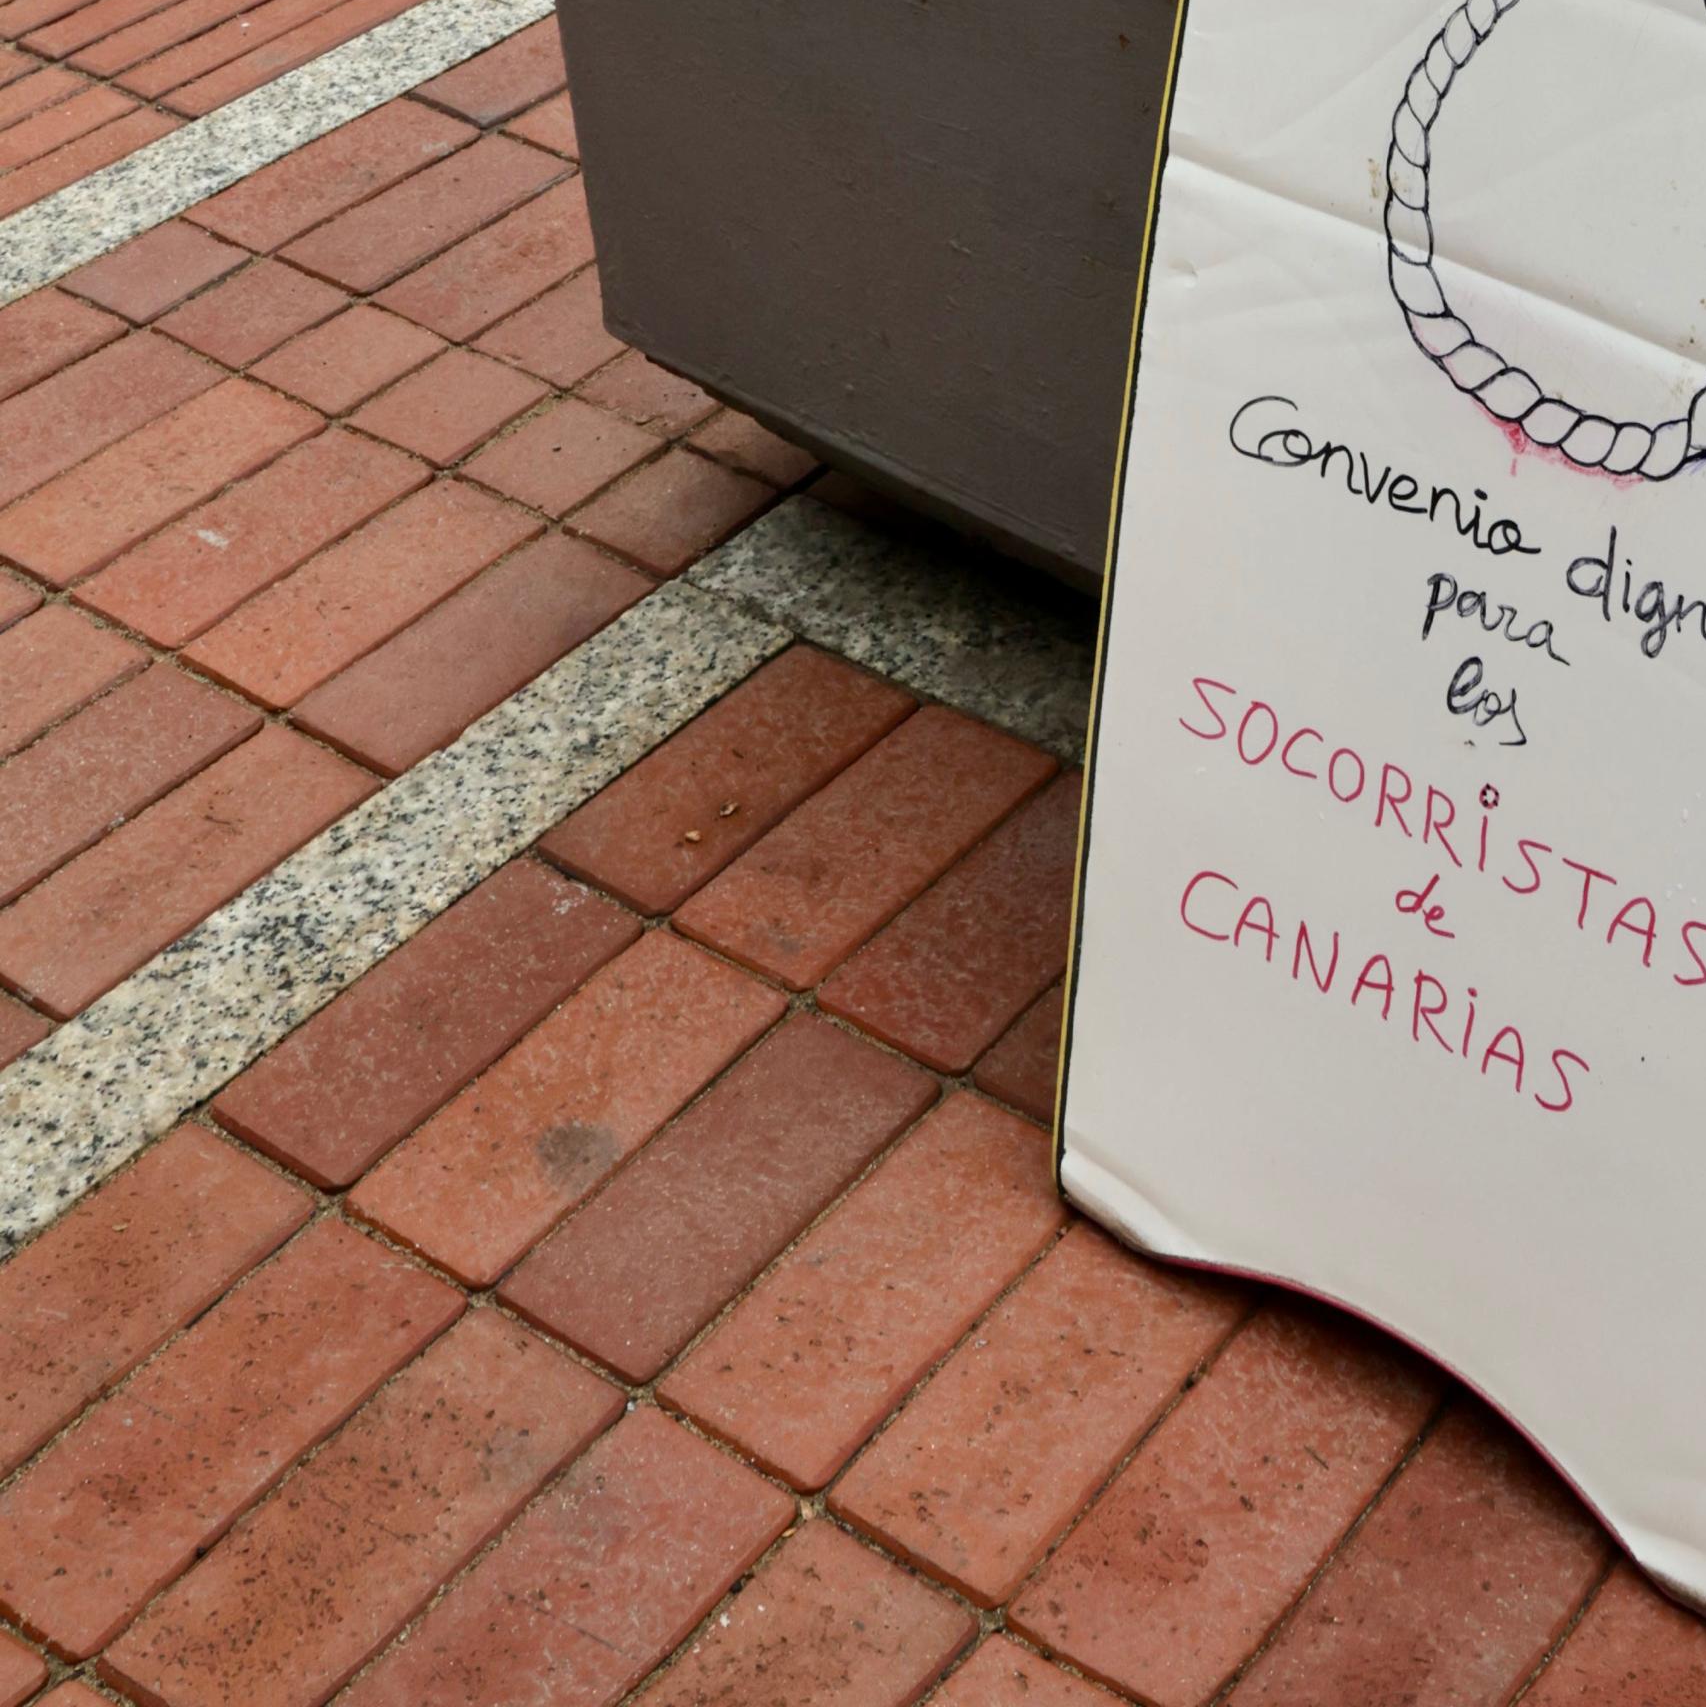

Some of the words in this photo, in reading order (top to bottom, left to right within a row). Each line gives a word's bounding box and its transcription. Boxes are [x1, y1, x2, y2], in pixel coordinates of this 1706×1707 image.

[1230, 396, 1541, 555] Convenio
[1422, 572, 1571, 667] para
[1446, 656, 1527, 745] los
[1395, 874, 1455, 938] de
